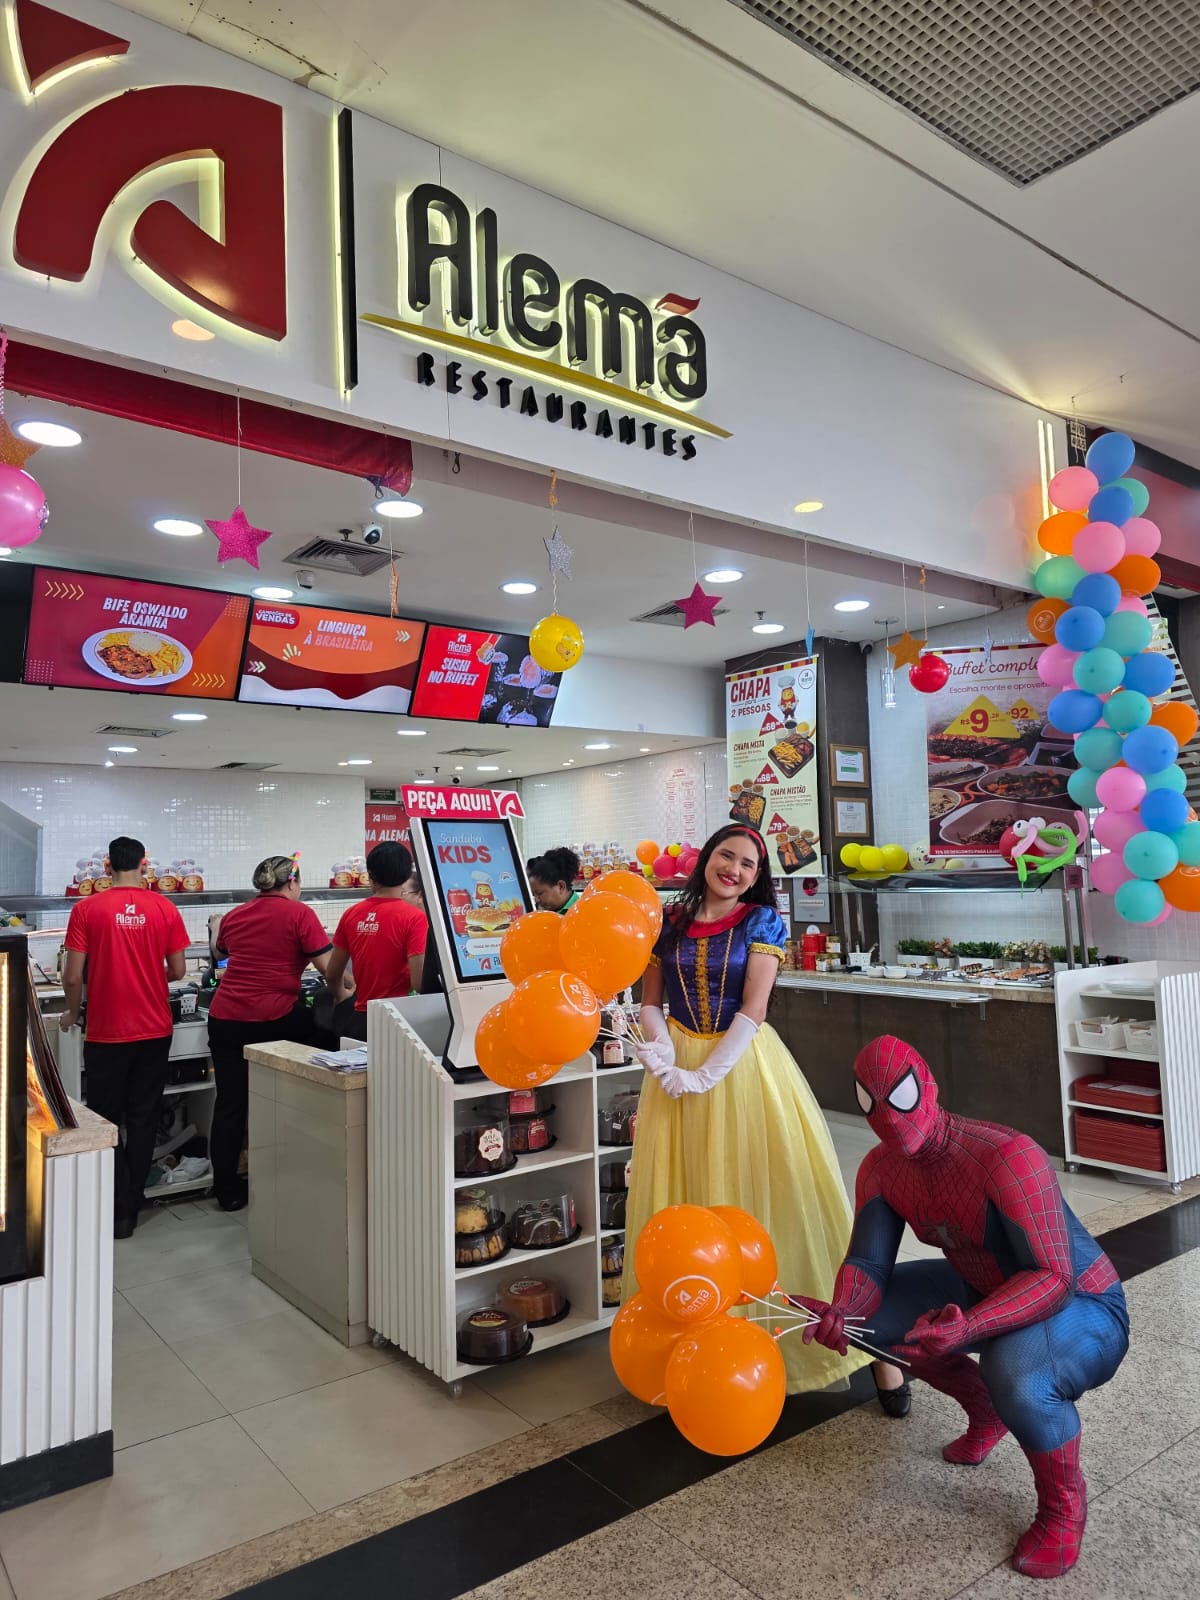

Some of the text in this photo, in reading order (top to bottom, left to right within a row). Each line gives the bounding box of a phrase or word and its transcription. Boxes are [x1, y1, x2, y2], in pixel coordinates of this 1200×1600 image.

[406, 183, 708, 402] Alemã
[416, 352, 697, 460] RESTAURANTES
[103, 597, 188, 620] BIFE OSWALDO
[119, 612, 169, 630] ARANHA
[255, 612, 295, 625] VENDAS
[317, 619, 367, 638] LINGUIÇA
[315, 633, 374, 652] BRASILEIRA
[441, 657, 471, 672] SUSHI
[989, 657, 1039, 676] comple
[427, 670, 480, 686] NO BUFFET
[730, 676, 771, 703] CHAPA
[981, 684, 1006, 692] monte
[731, 702, 771, 718] 2 PESSOAS
[1011, 707, 1030, 719] 92
[970, 709, 989, 733] 9
[407, 790, 447, 815] PEÇA
[450, 793, 492, 812] AQUI!
[378, 827, 410, 841] ALEMÃ
[440, 833, 484, 843] Sanduba
[437, 845, 492, 864] KIDS
[115, 912, 146, 925] Alemã
